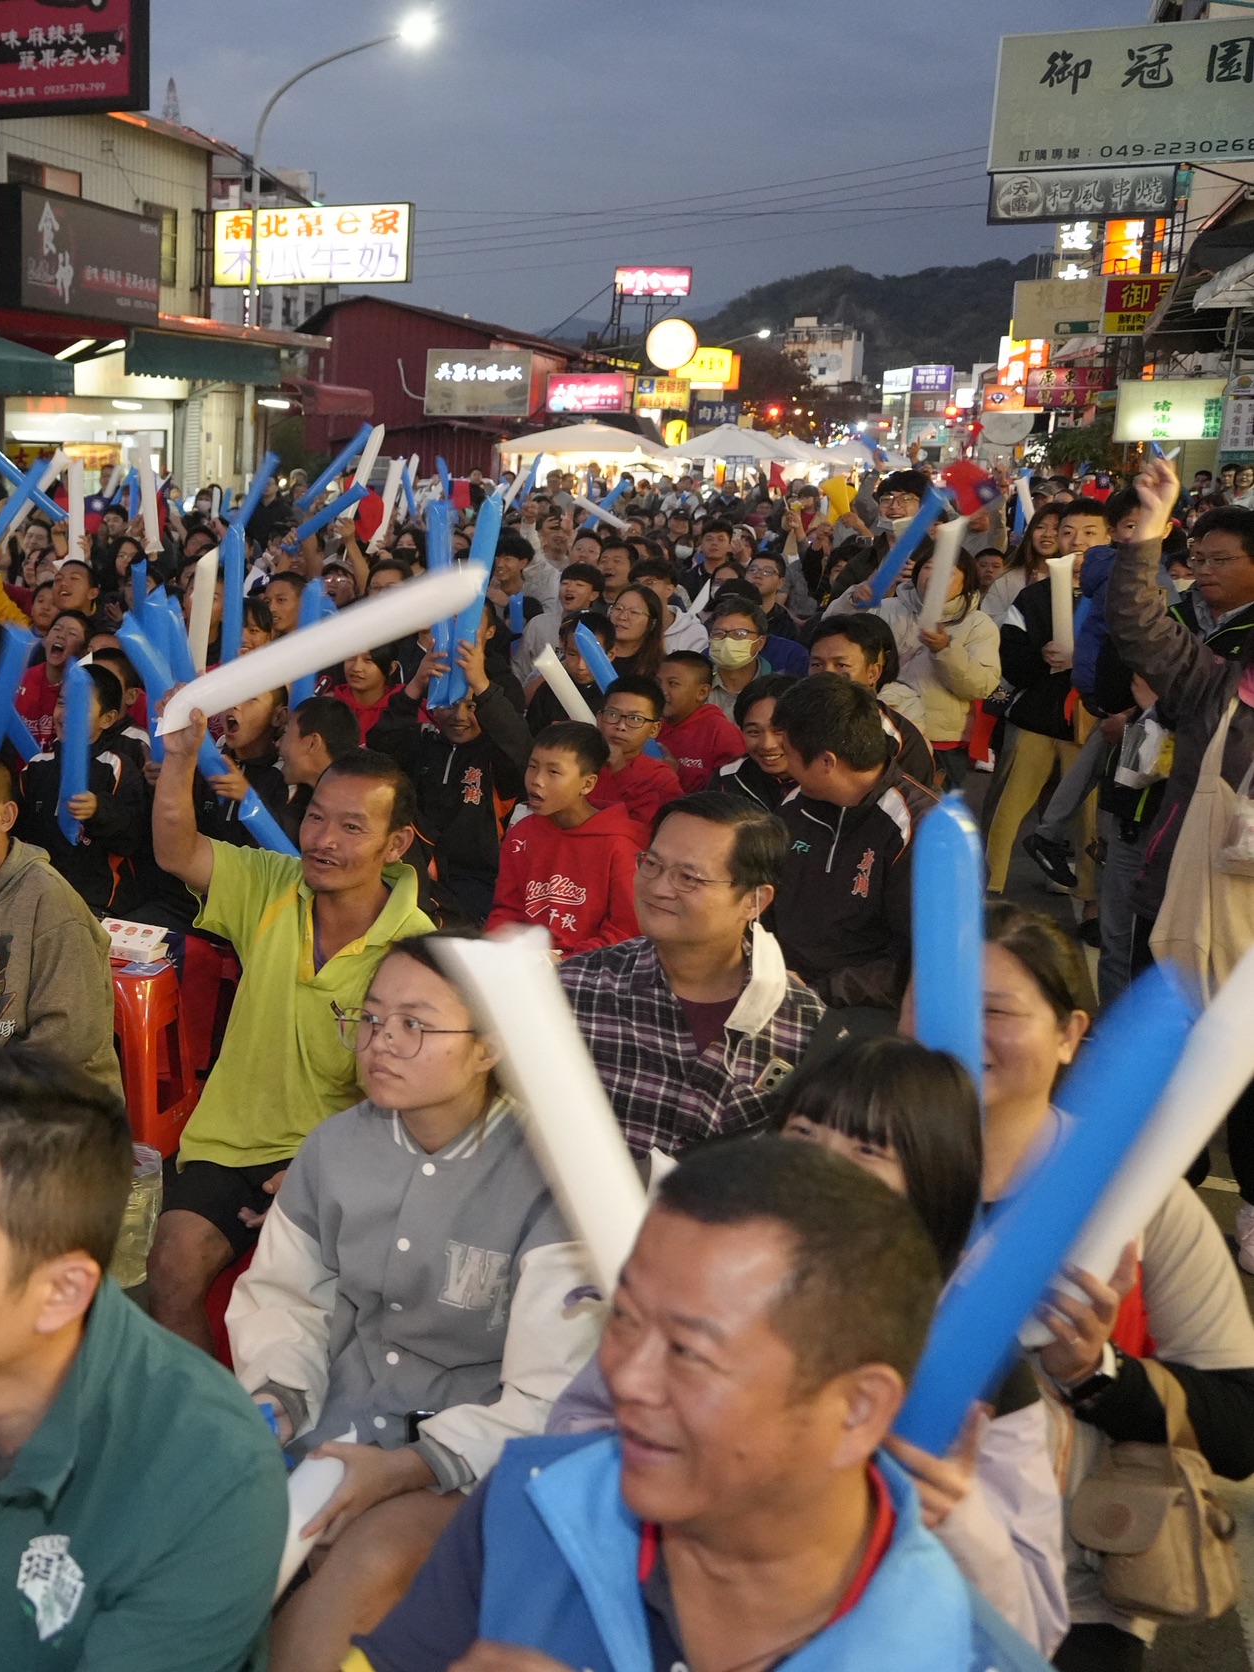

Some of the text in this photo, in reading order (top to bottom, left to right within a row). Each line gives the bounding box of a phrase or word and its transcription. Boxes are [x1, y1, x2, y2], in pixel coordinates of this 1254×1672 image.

[1039, 36, 1254, 95] 御冠園
[222, 242, 400, 282] 木瓜牛奶
[1117, 314, 1151, 323] 鮮肉
[548, 908, 577, 932] 千秋
